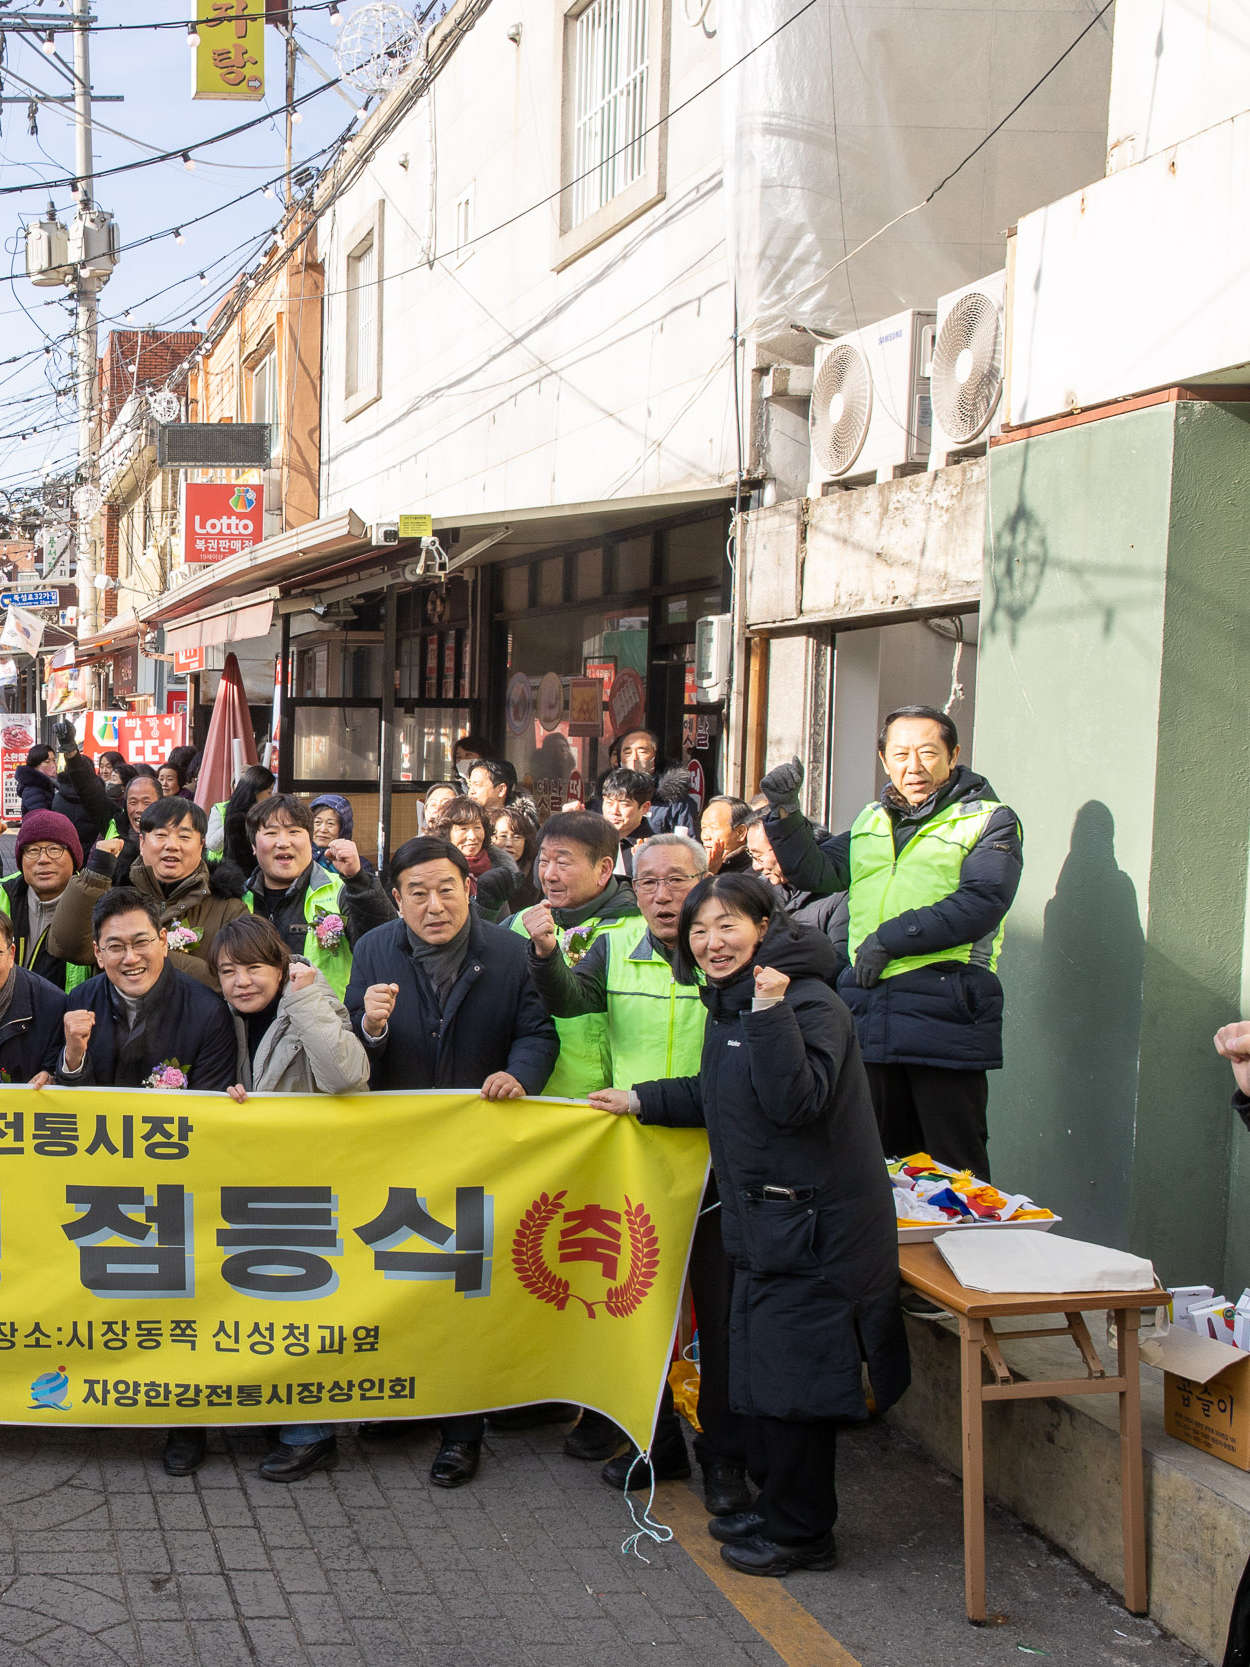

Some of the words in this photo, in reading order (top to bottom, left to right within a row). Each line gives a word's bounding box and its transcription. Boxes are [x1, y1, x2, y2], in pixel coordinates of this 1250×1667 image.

[194, 515, 254, 534] Lotto
[194, 539, 254, 553] 복권판매점
[124, 716, 175, 739] 빨강이
[60, 1184, 495, 1301] 점등식
[556, 1203, 622, 1283] 축
[211, 1319, 382, 1357] 신성청과옆
[81, 1375, 417, 1411] 자양한강전통시장상인회
